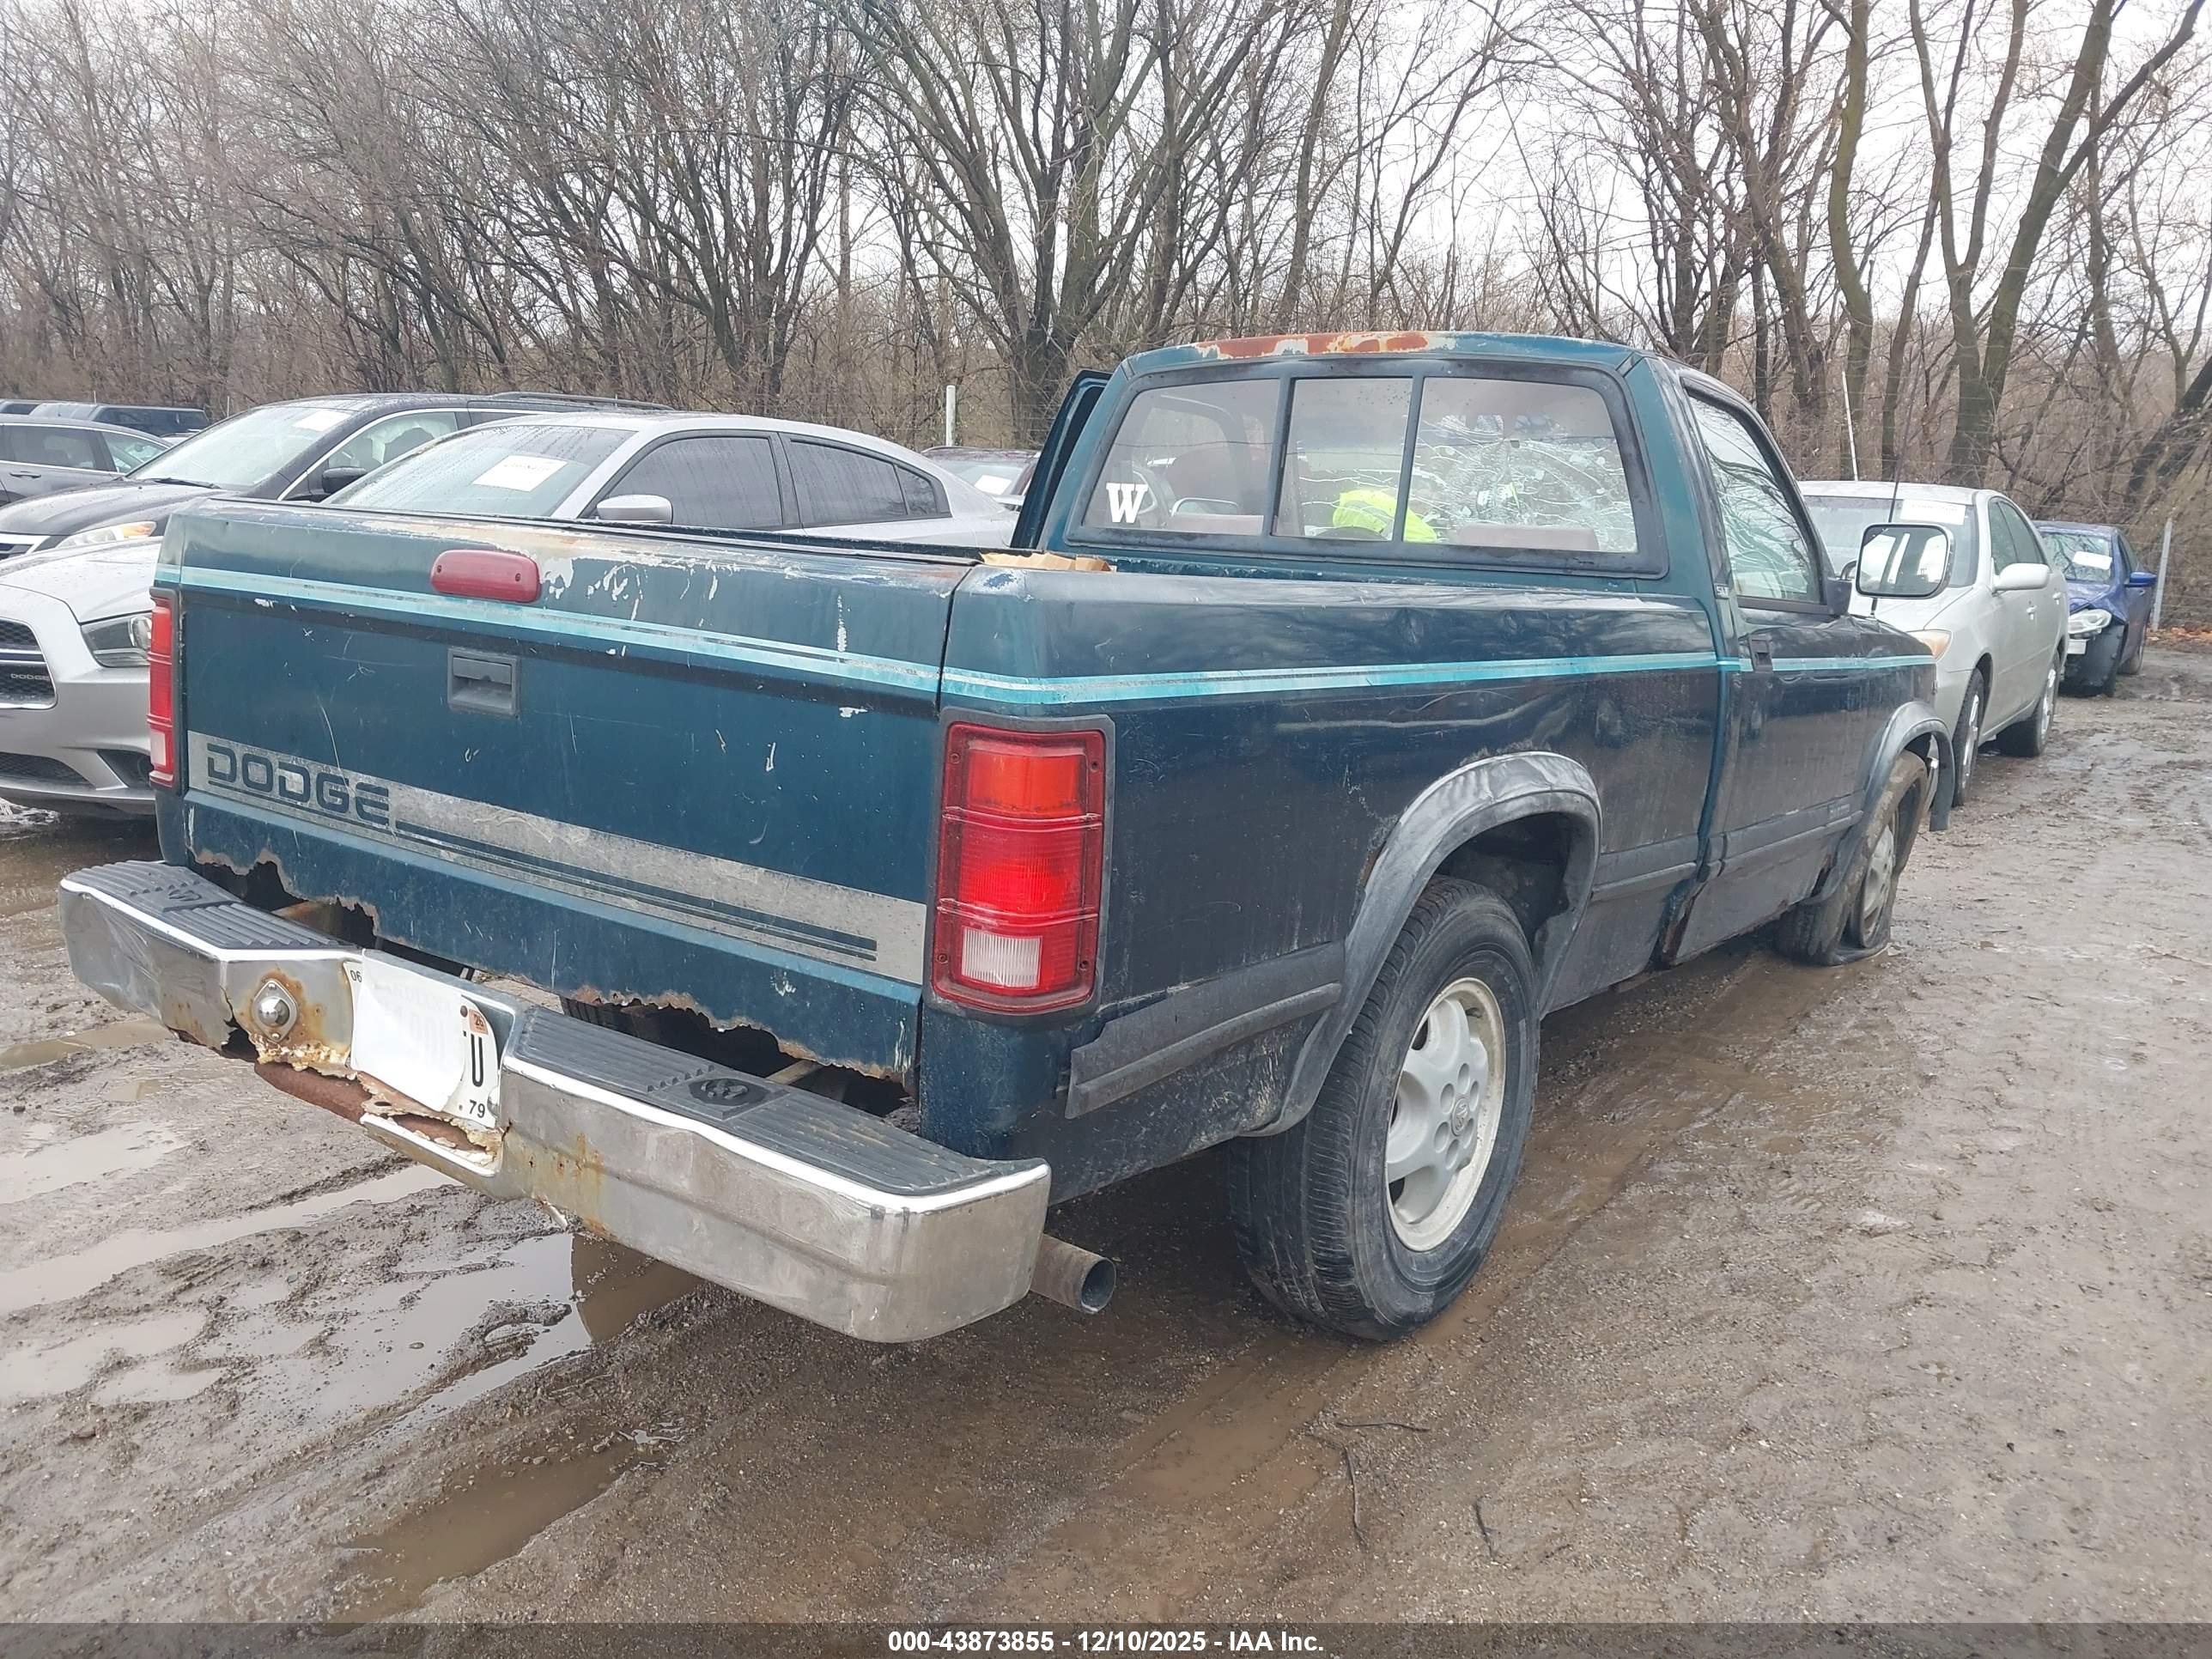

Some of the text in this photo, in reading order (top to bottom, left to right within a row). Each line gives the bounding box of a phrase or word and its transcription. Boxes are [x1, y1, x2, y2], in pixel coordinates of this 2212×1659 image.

[1106, 483, 1148, 523] W
[206, 743, 389, 826] DODGE
[349, 969, 362, 983] 06
[469, 1099, 486, 1118] 79
